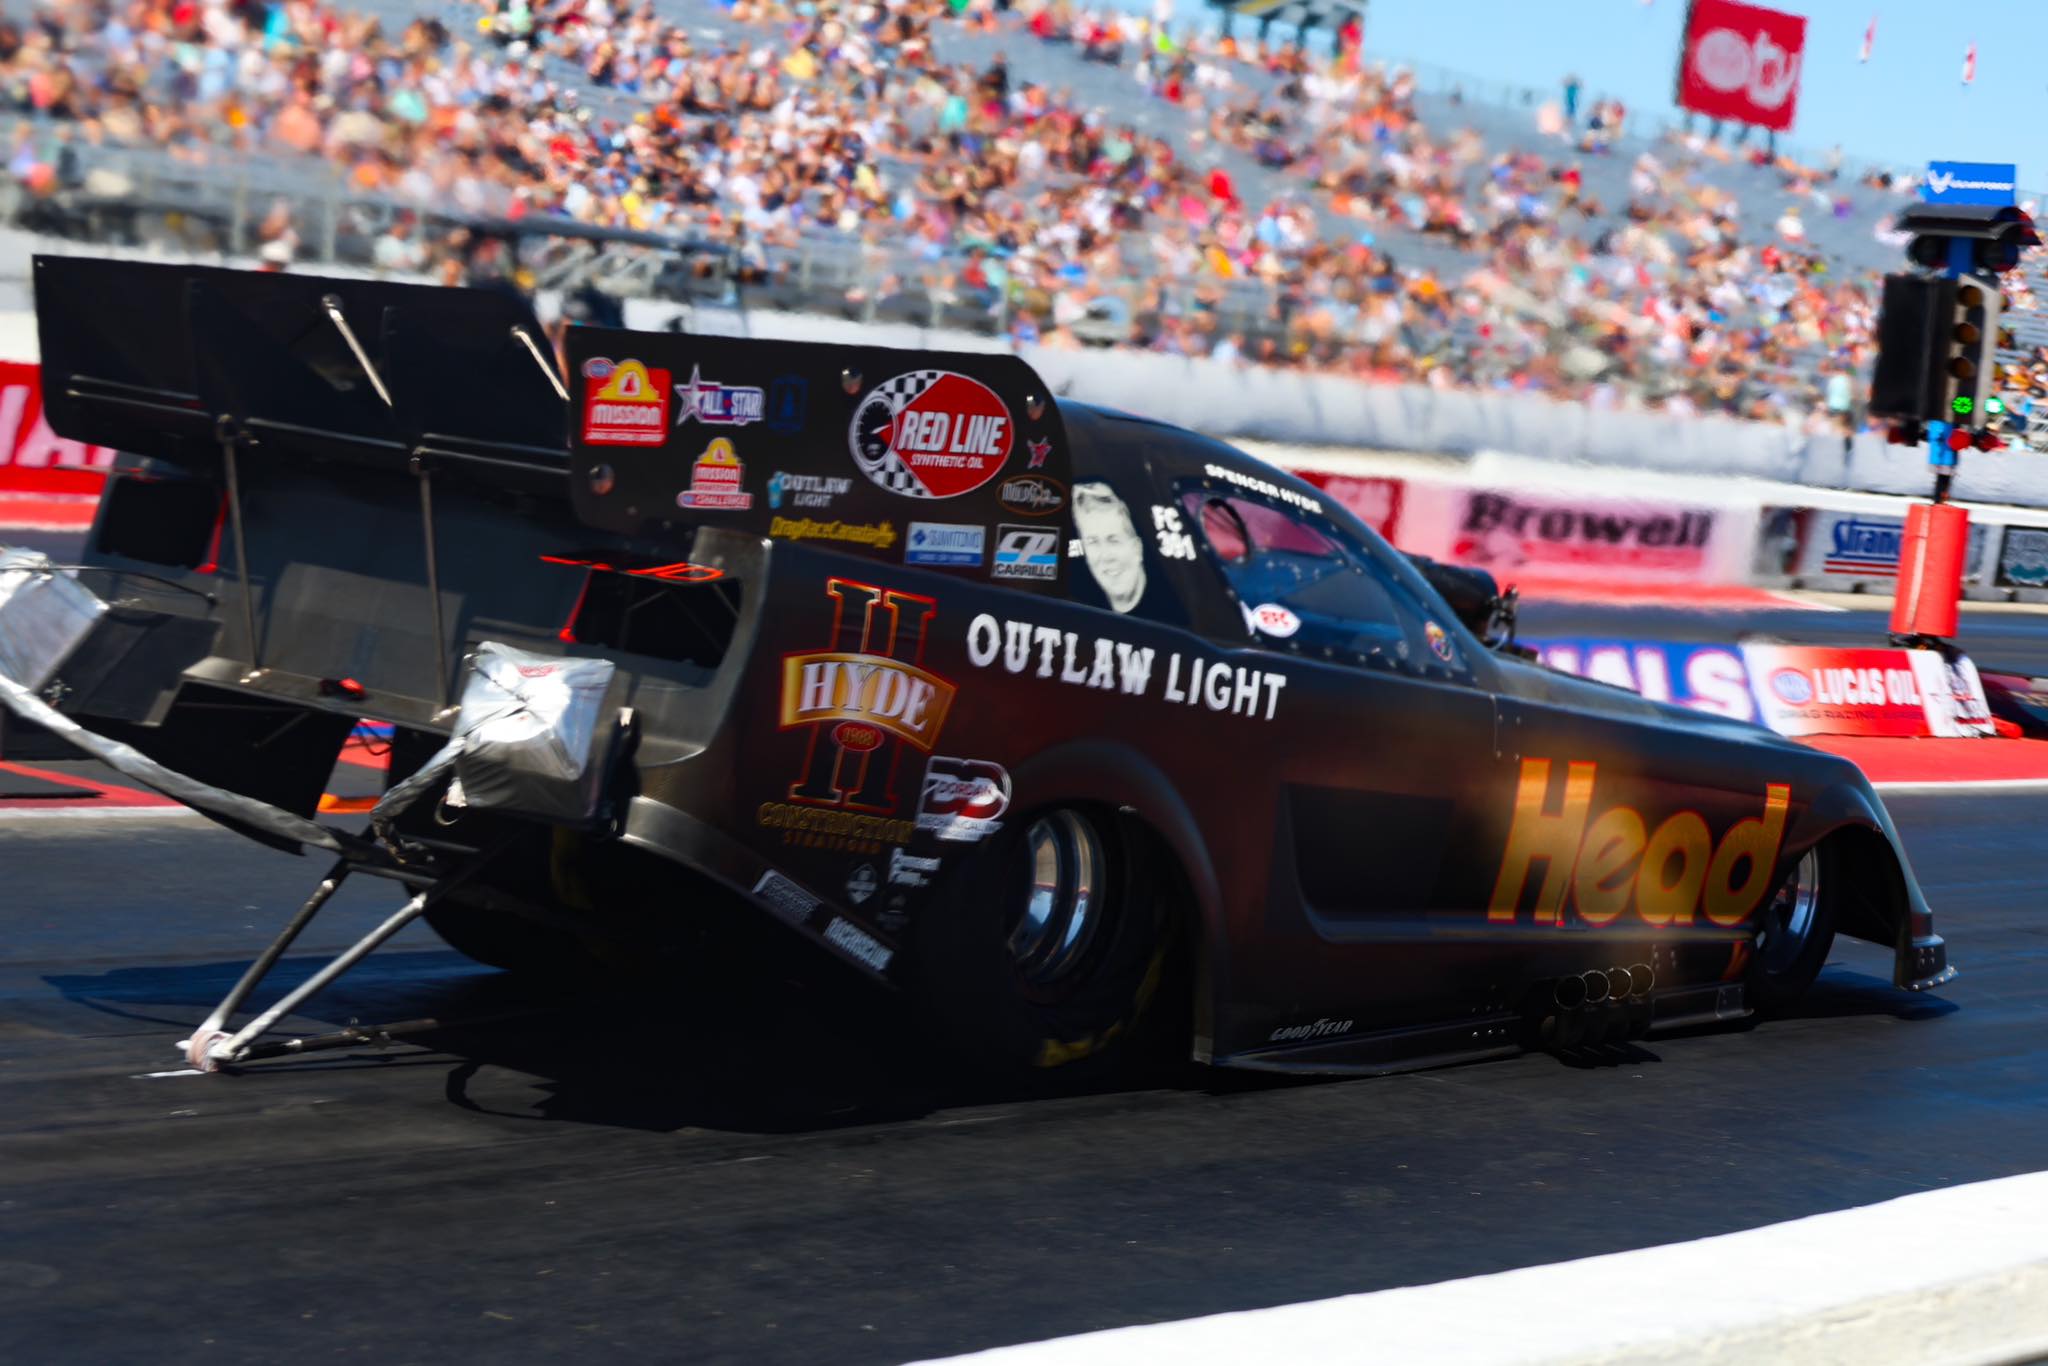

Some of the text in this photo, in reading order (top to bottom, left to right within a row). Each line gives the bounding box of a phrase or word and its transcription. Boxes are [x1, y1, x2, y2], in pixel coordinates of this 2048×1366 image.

[702, 390, 762, 416] ALL STAR
[897, 410, 1008, 456] RED LINE
[910, 454, 985, 469] SYNTHETIC OIL
[781, 473, 853, 494] OUTLAW
[1203, 463, 1279, 499] SPENCER
[1281, 487, 1324, 515] HYDE
[1151, 505, 1183, 532] FC
[1463, 490, 1716, 547] Browell
[1827, 518, 1902, 561] Stran
[995, 563, 1056, 578] CARRILLO
[966, 613, 1287, 722] OUTLAW LIGHT
[1813, 668, 1885, 707] LUCAS
[1885, 669, 1921, 707] OIL
[797, 661, 936, 733] HYDE
[758, 801, 914, 844] CONSTRUCTION
[1489, 756, 1791, 927] Head
[1269, 1017, 1354, 1041] GOODYEAR
